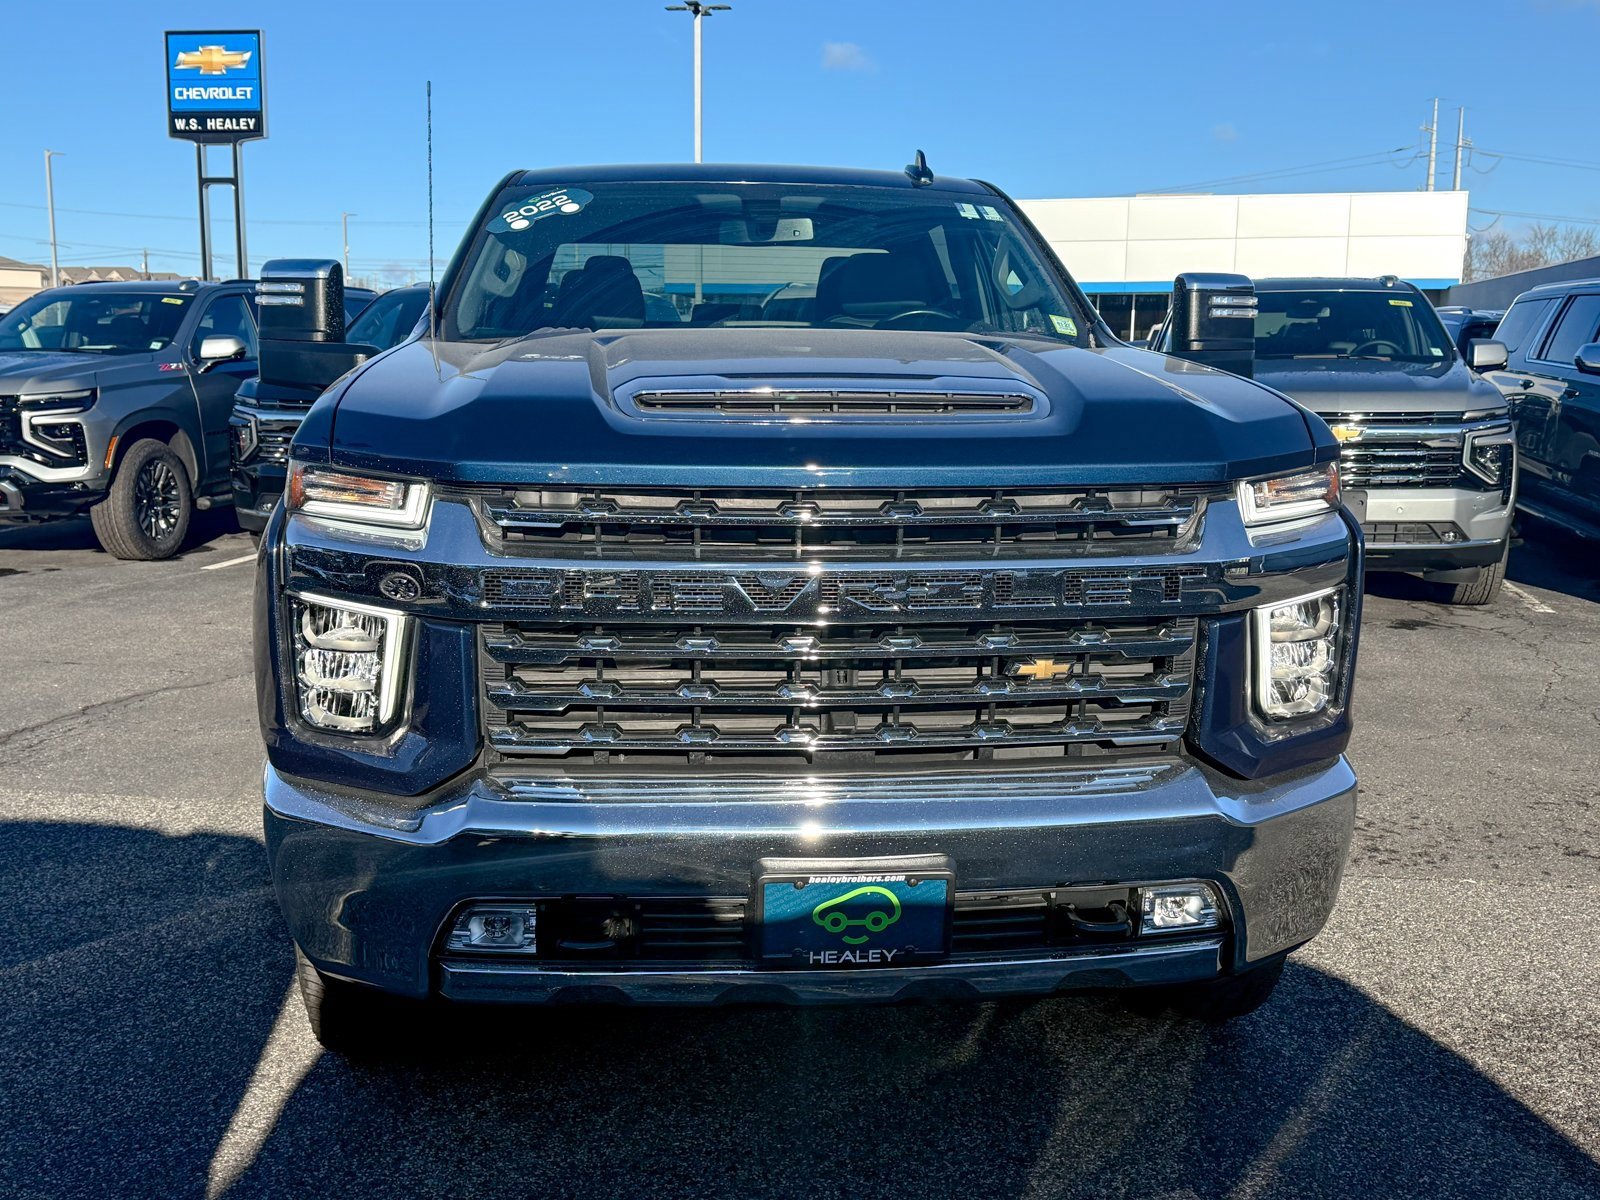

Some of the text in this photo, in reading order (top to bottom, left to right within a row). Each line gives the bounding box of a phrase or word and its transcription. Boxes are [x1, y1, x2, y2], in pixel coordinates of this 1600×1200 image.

[174, 87, 253, 100] CHEVROLET
[174, 117, 256, 131] W.S. HEALEY
[503, 194, 572, 223] 2022
[482, 566, 1207, 611] CHEVROLET
[809, 875, 905, 884] healeybrothers.com
[809, 949, 898, 965] HEALEY
